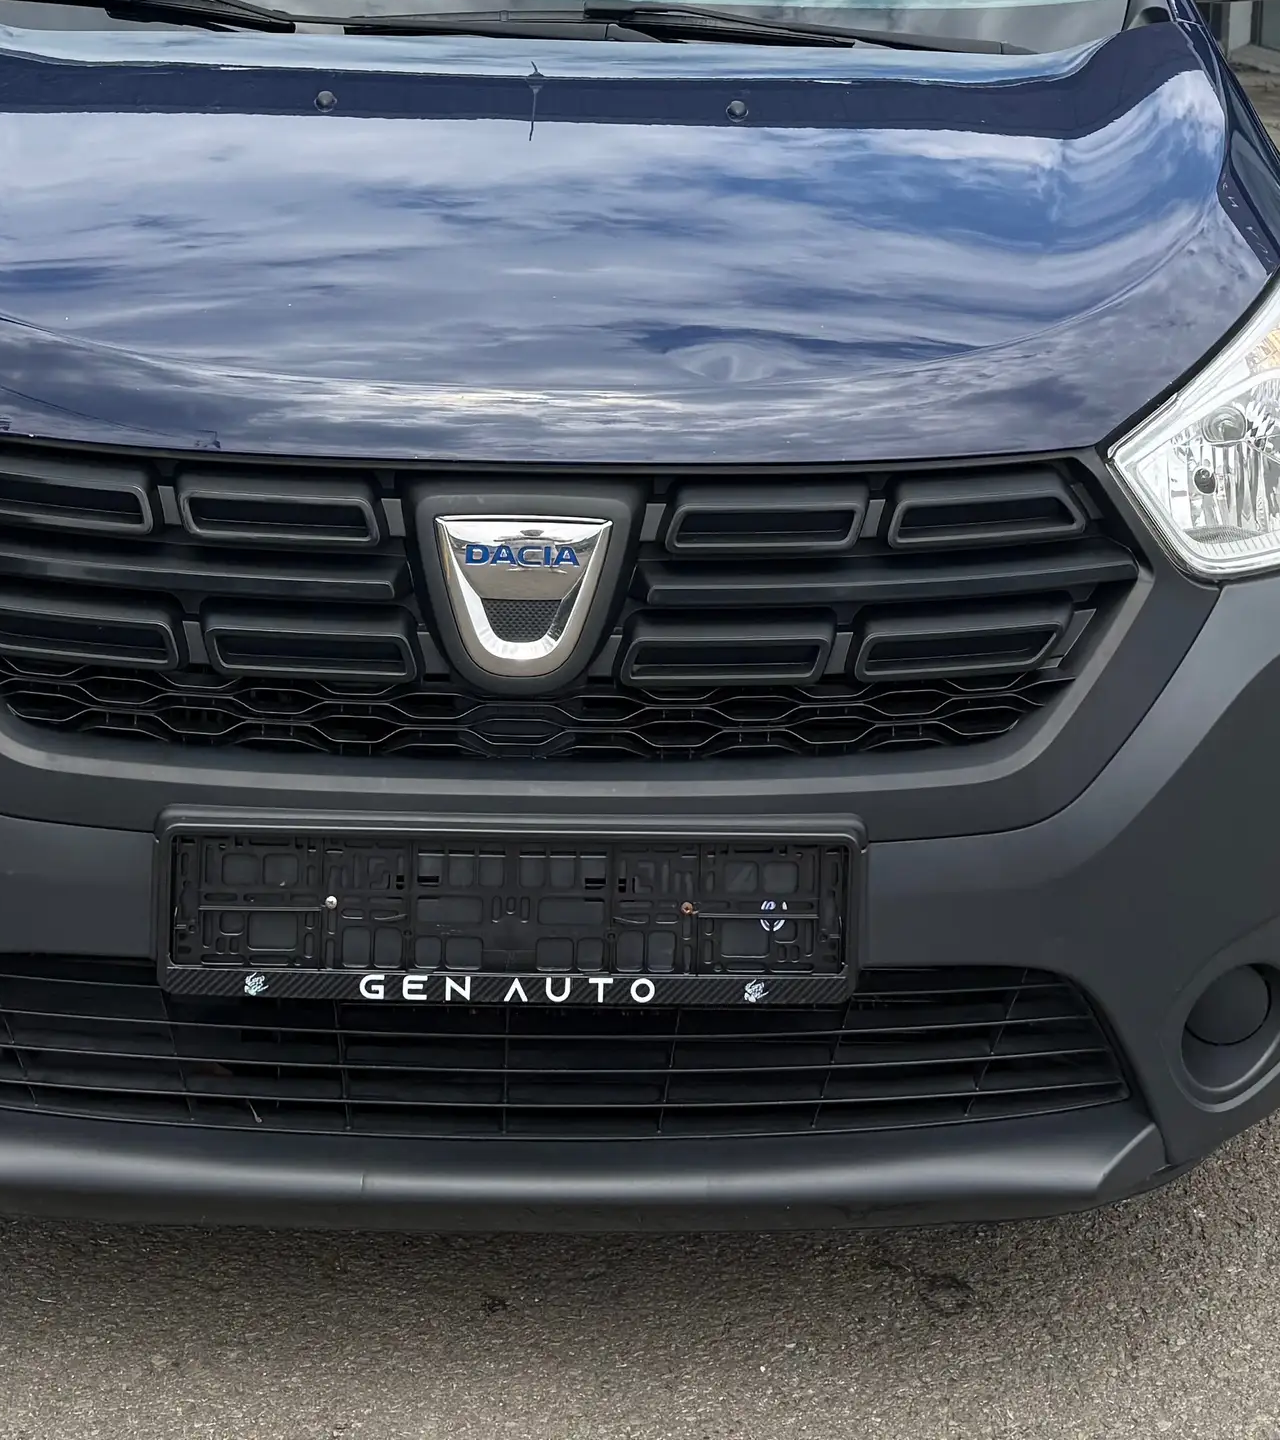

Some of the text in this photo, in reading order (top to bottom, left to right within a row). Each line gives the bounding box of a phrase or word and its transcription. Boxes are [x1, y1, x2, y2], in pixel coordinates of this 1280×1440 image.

[464, 543, 580, 568] DACIA
[359, 974, 657, 1004] GEN AUTO
